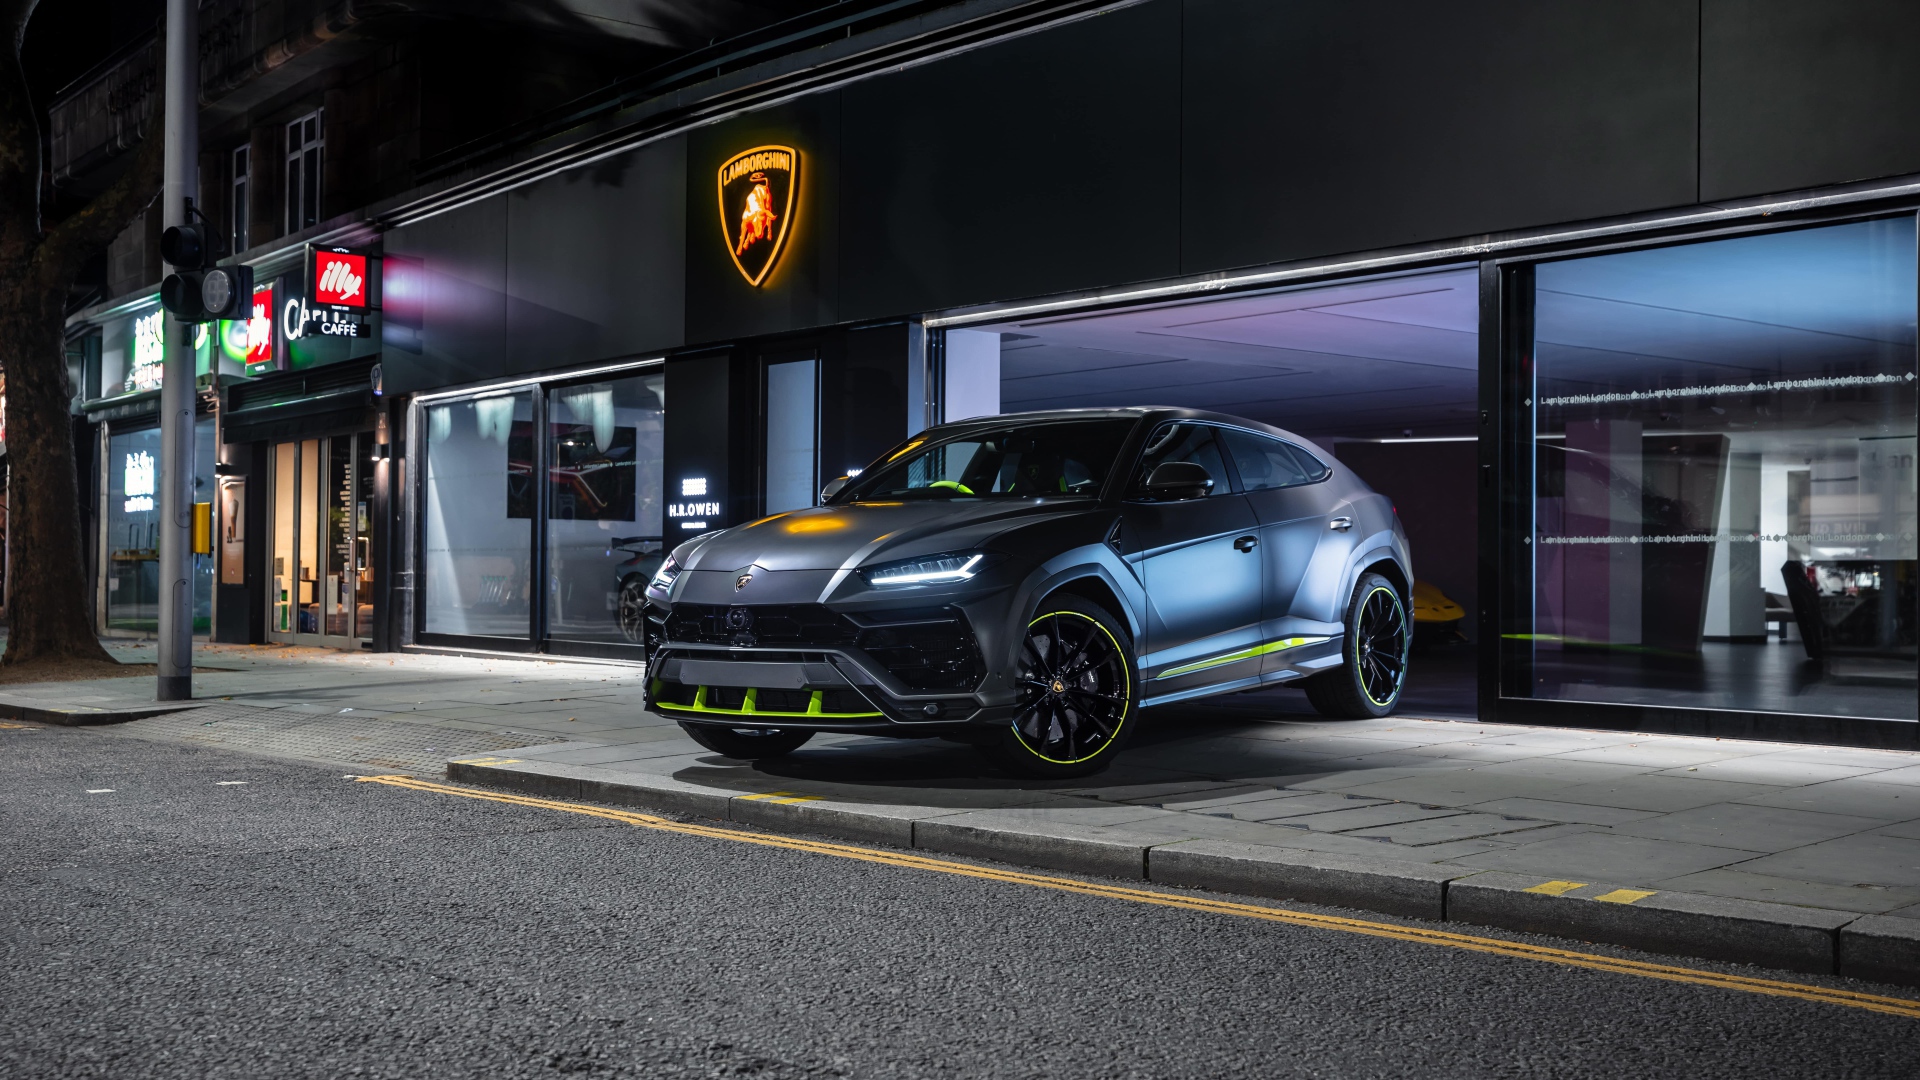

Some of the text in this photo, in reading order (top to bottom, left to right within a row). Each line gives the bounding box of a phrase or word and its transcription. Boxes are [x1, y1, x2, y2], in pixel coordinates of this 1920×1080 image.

[723, 152, 790, 187] LAMBORGHINI
[319, 260, 362, 300] illy
[321, 322, 357, 337] CAFFÈ
[1767, 377, 1825, 390] Lamborghini
[1648, 386, 1701, 398] Lamborghini
[1540, 394, 1589, 406] Lamborghini
